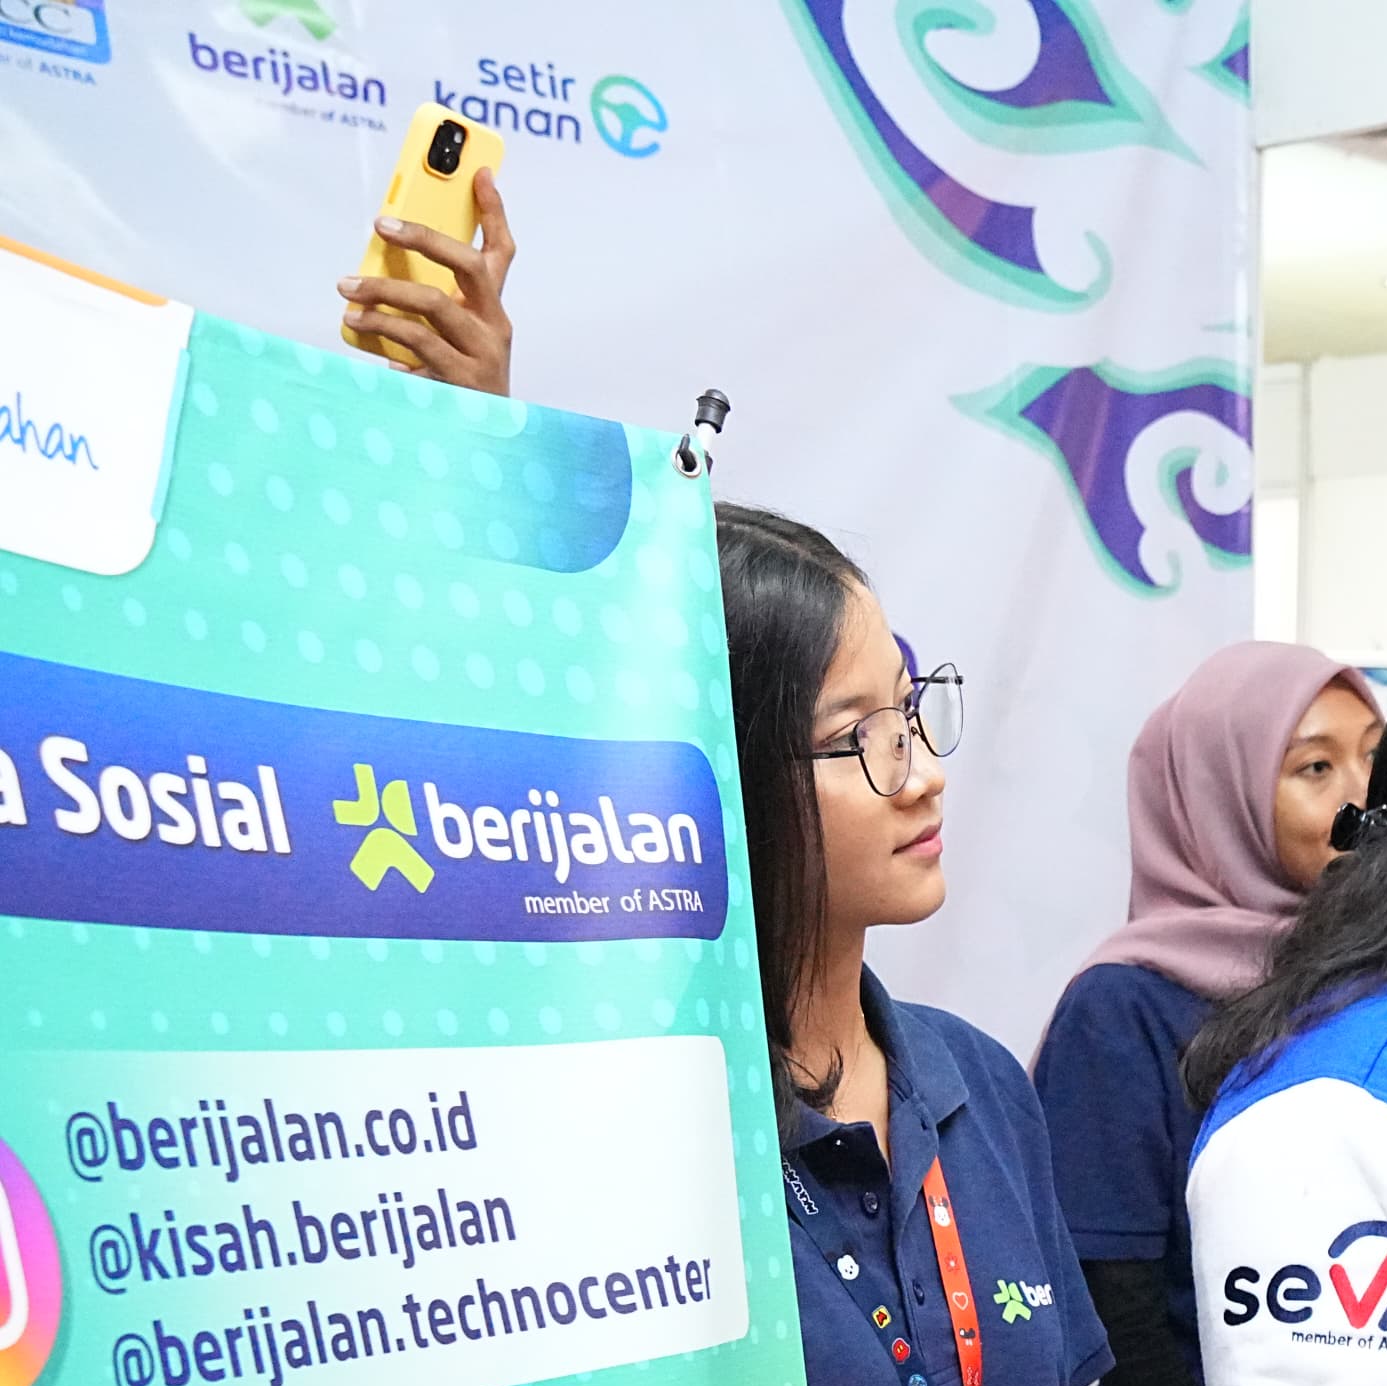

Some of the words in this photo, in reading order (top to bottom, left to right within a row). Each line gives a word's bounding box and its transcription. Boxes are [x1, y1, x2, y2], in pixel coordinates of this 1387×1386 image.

[187, 31, 387, 107] berijalan
[478, 57, 576, 102] setir
[434, 80, 582, 144] kanan
[40, 735, 292, 854] Sosial
[425, 780, 703, 885] berijalan
[525, 889, 609, 915] member
[621, 888, 643, 914] of
[648, 889, 704, 914] ASTRA
[65, 1090, 478, 1183] @berijalan.co.id
[89, 1187, 518, 1295] @kisah.berijalan
[1290, 1329, 1354, 1347] member
[1357, 1332, 1373, 1349] of
